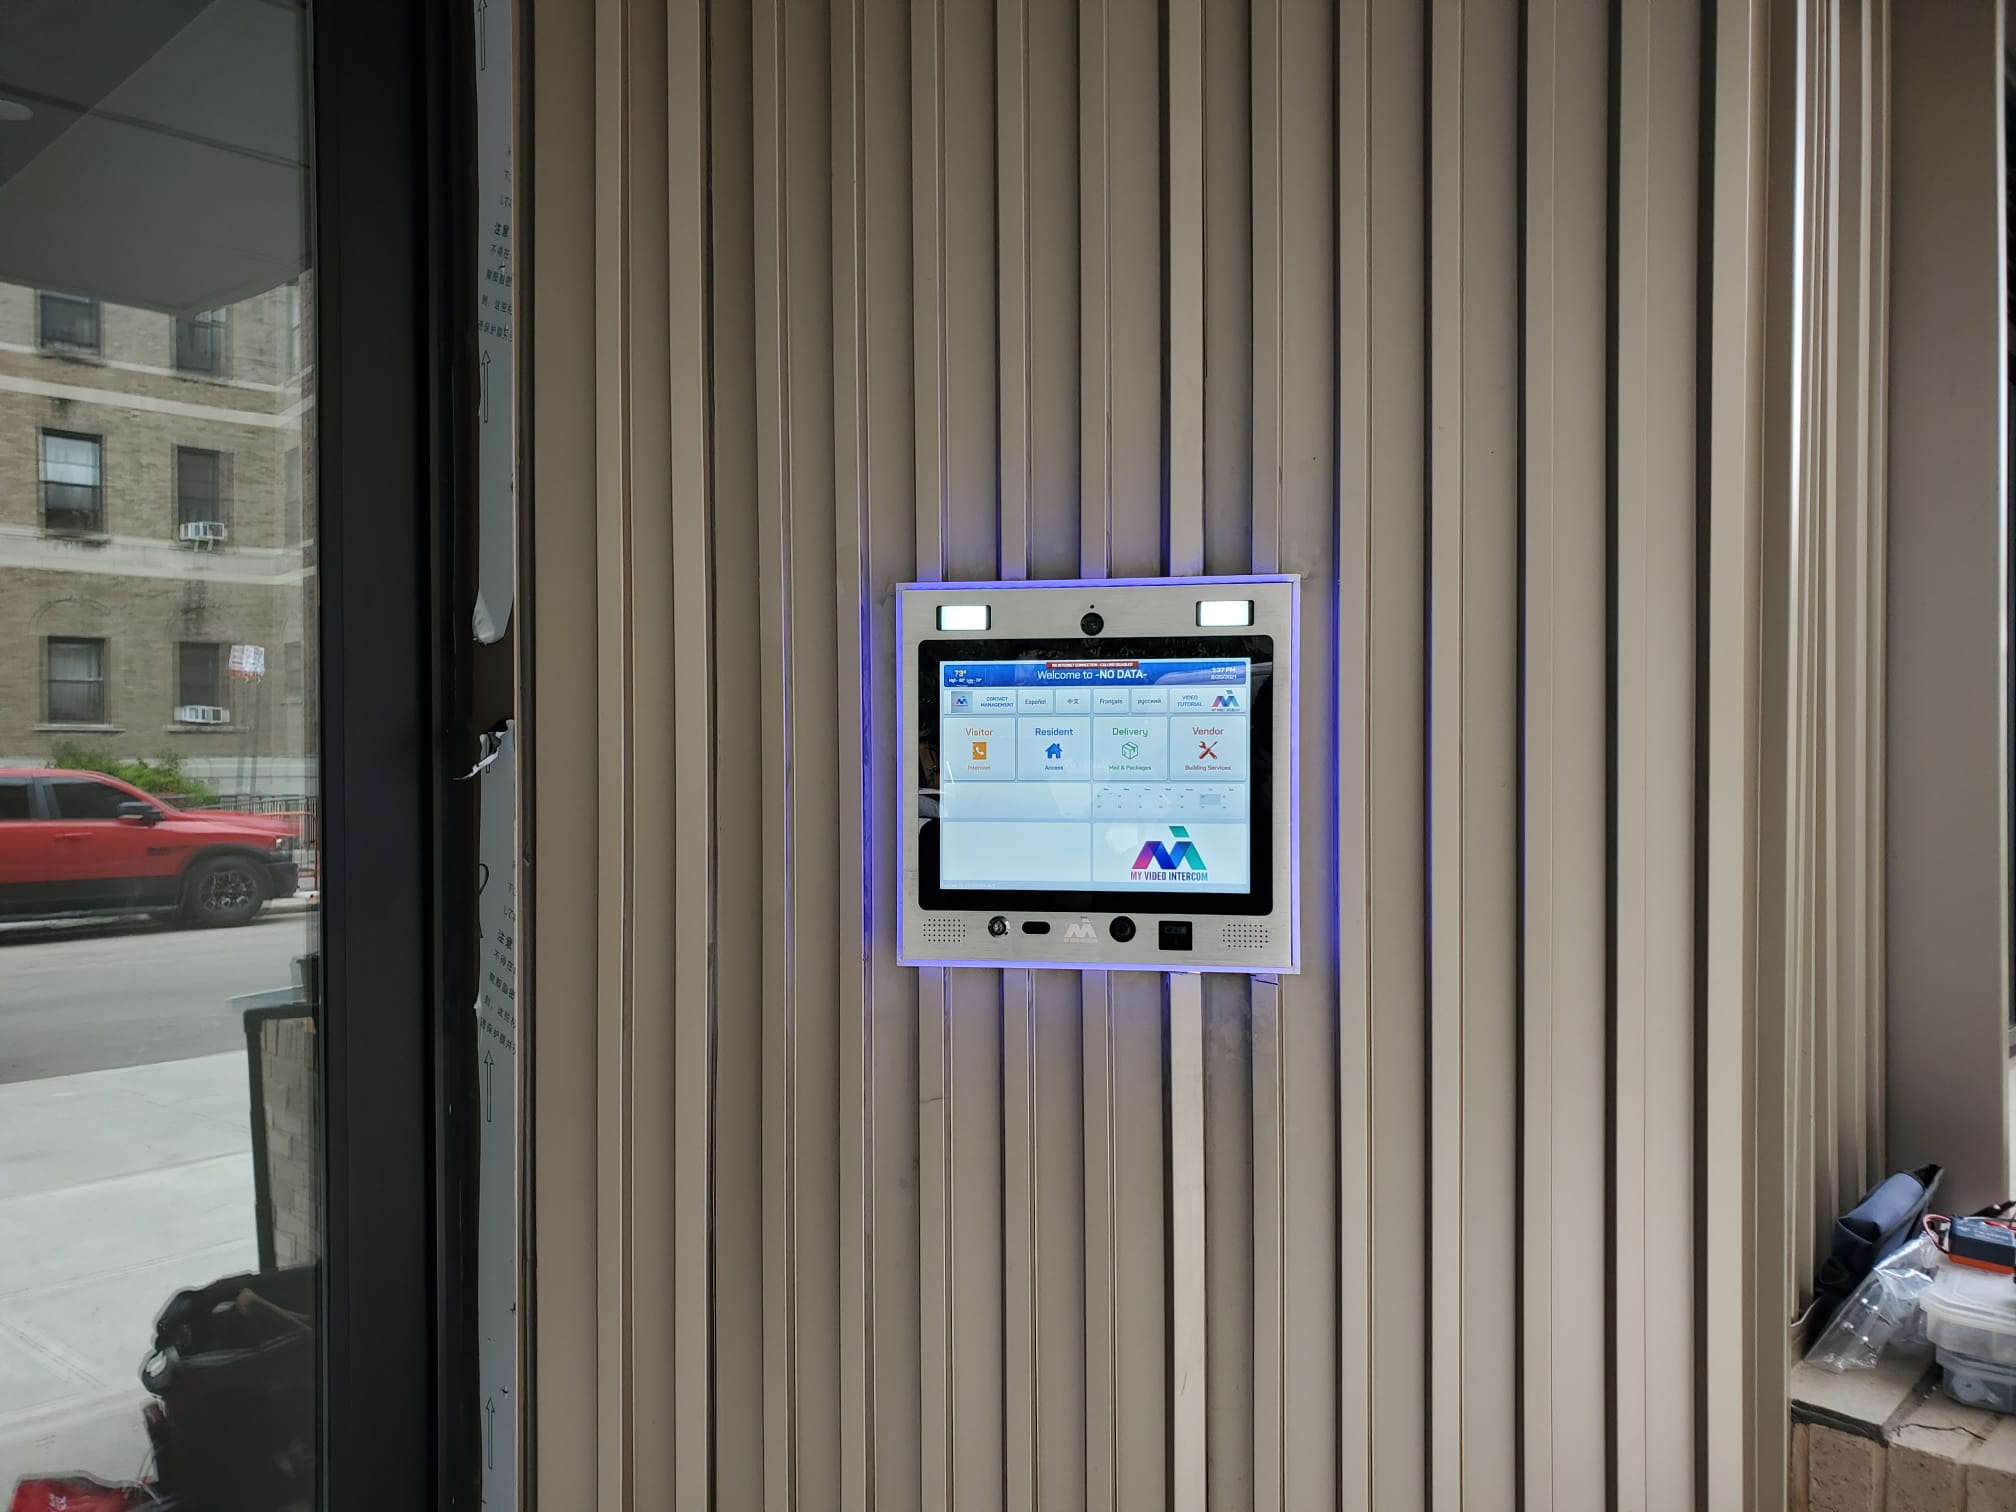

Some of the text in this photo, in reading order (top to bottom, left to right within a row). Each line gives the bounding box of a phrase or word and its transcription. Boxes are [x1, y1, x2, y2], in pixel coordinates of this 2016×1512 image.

[1037, 669, 1148, 680] Welcome to -NO DATA-
[1099, 698, 1123, 706] Français
[965, 728, 993, 736] Visitor
[1035, 727, 1074, 736] Resident
[1112, 727, 1149, 737] Delivery
[1192, 727, 1224, 736] Vendor
[1130, 871, 1208, 882] MY VIDEO INTERCOM
